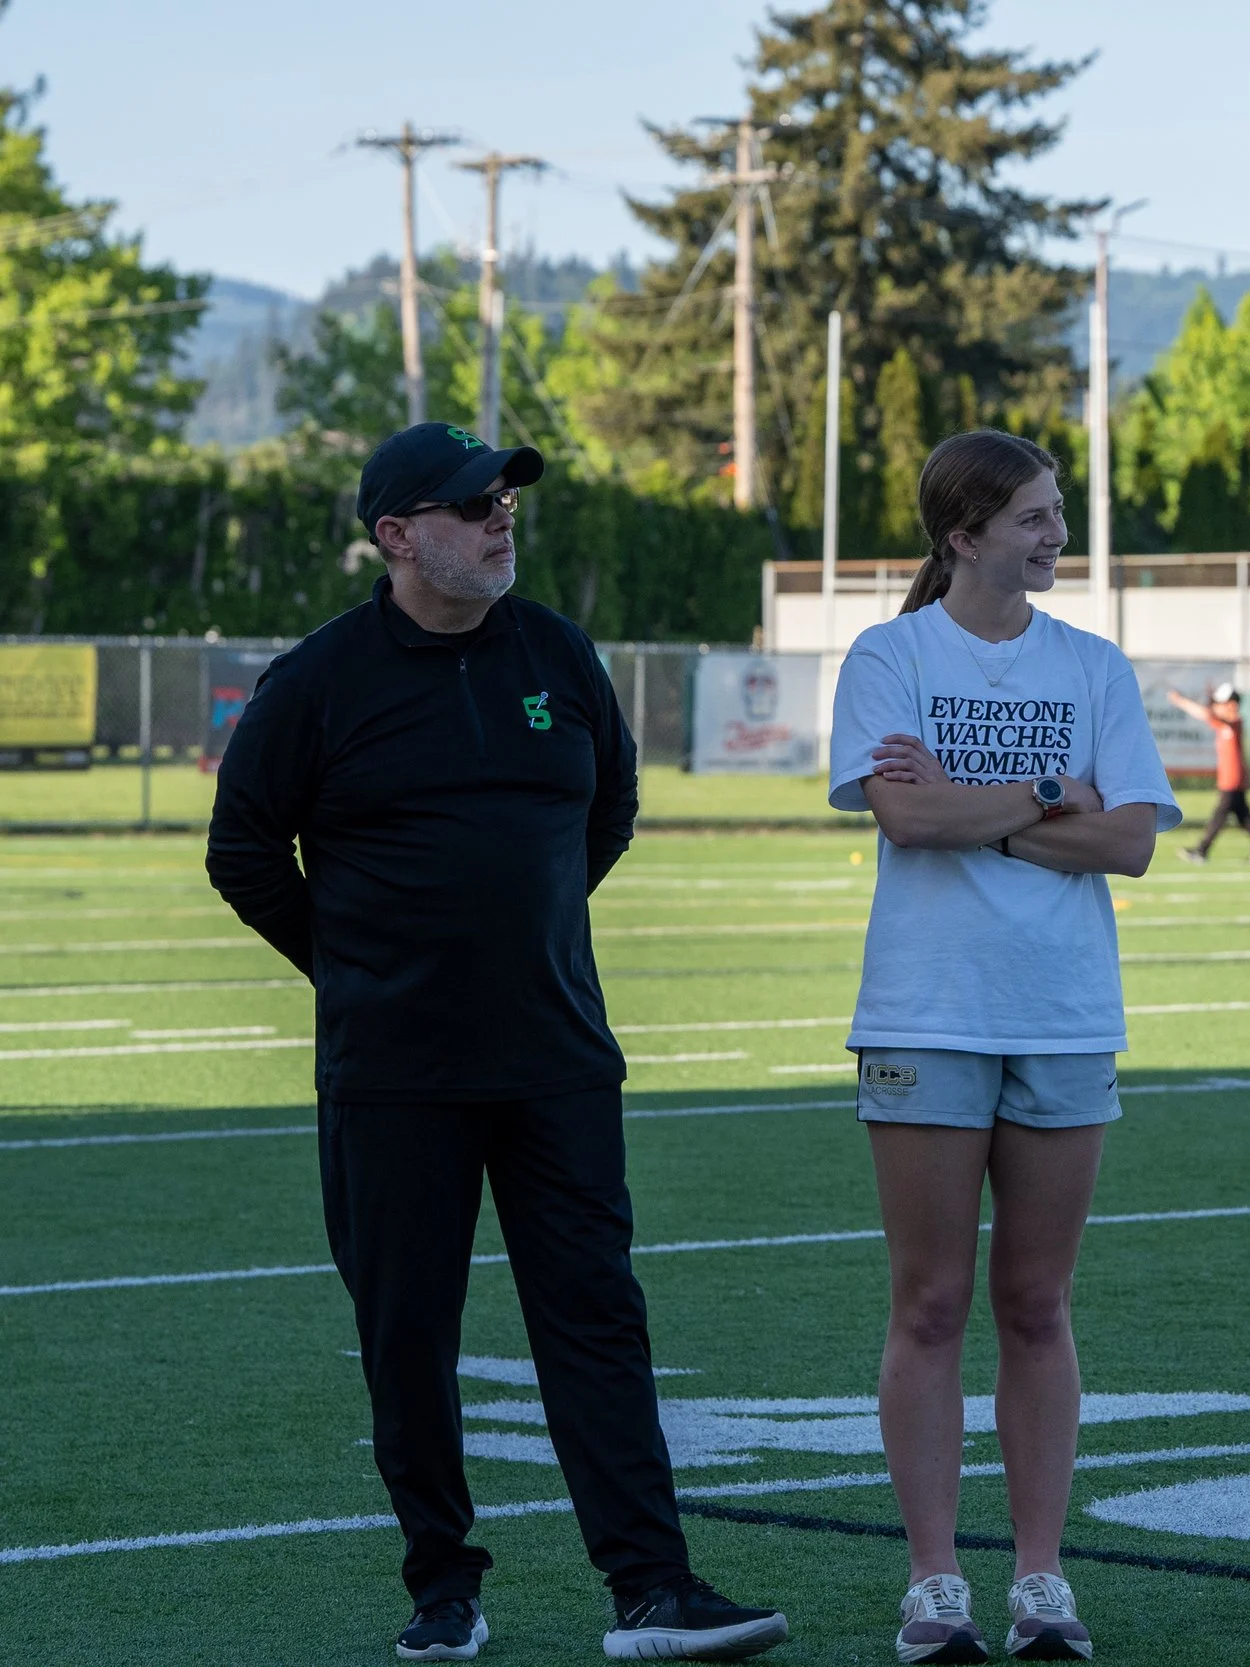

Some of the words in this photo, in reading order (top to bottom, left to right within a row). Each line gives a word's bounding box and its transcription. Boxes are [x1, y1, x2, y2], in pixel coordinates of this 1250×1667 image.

[928, 696, 1076, 725] EVERYONE
[935, 722, 1072, 749] WATCHES
[935, 748, 1070, 776] WOMEN'S
[866, 1063, 916, 1086] UCCS
